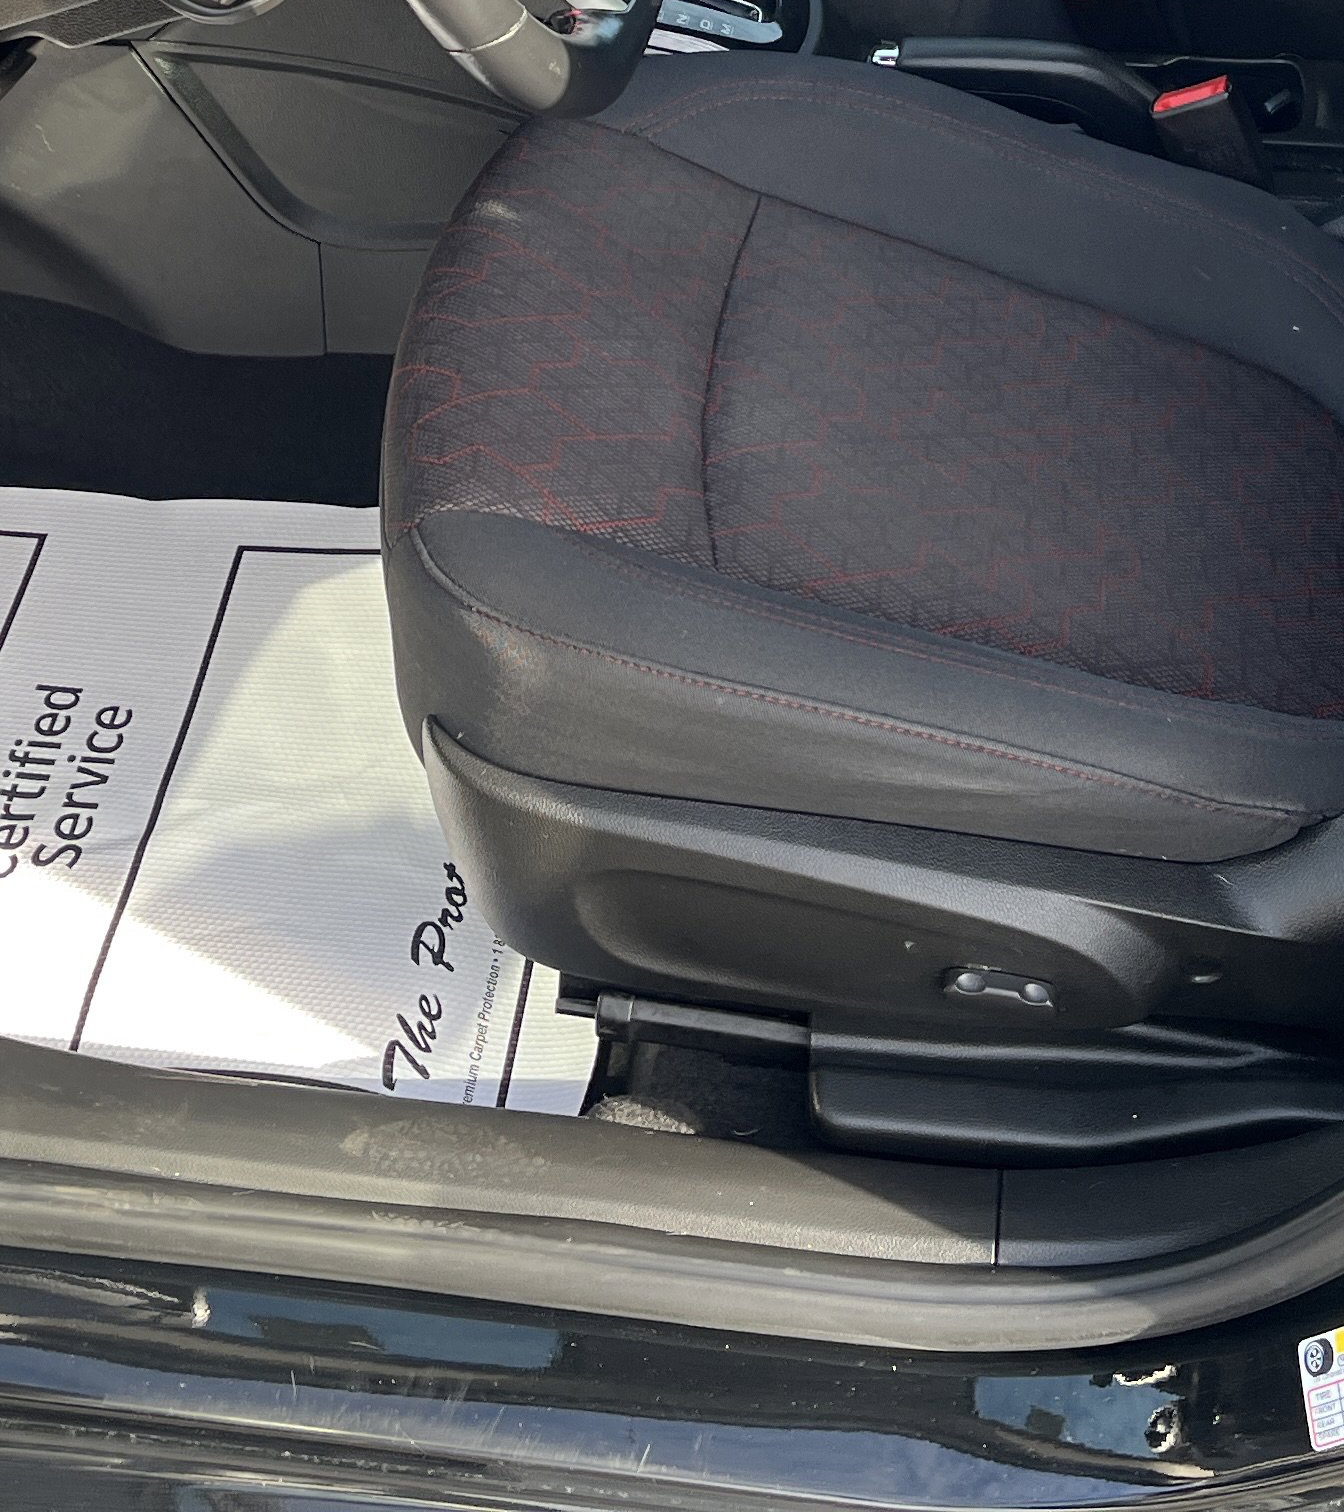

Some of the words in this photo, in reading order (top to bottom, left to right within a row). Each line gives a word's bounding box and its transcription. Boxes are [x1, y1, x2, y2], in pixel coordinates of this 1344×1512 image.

[30, 705, 133, 869] Service
[477, 964, 501, 1023] Protection
[382, 992, 443, 1092] The
[469, 1024, 489, 1062] Carpet
